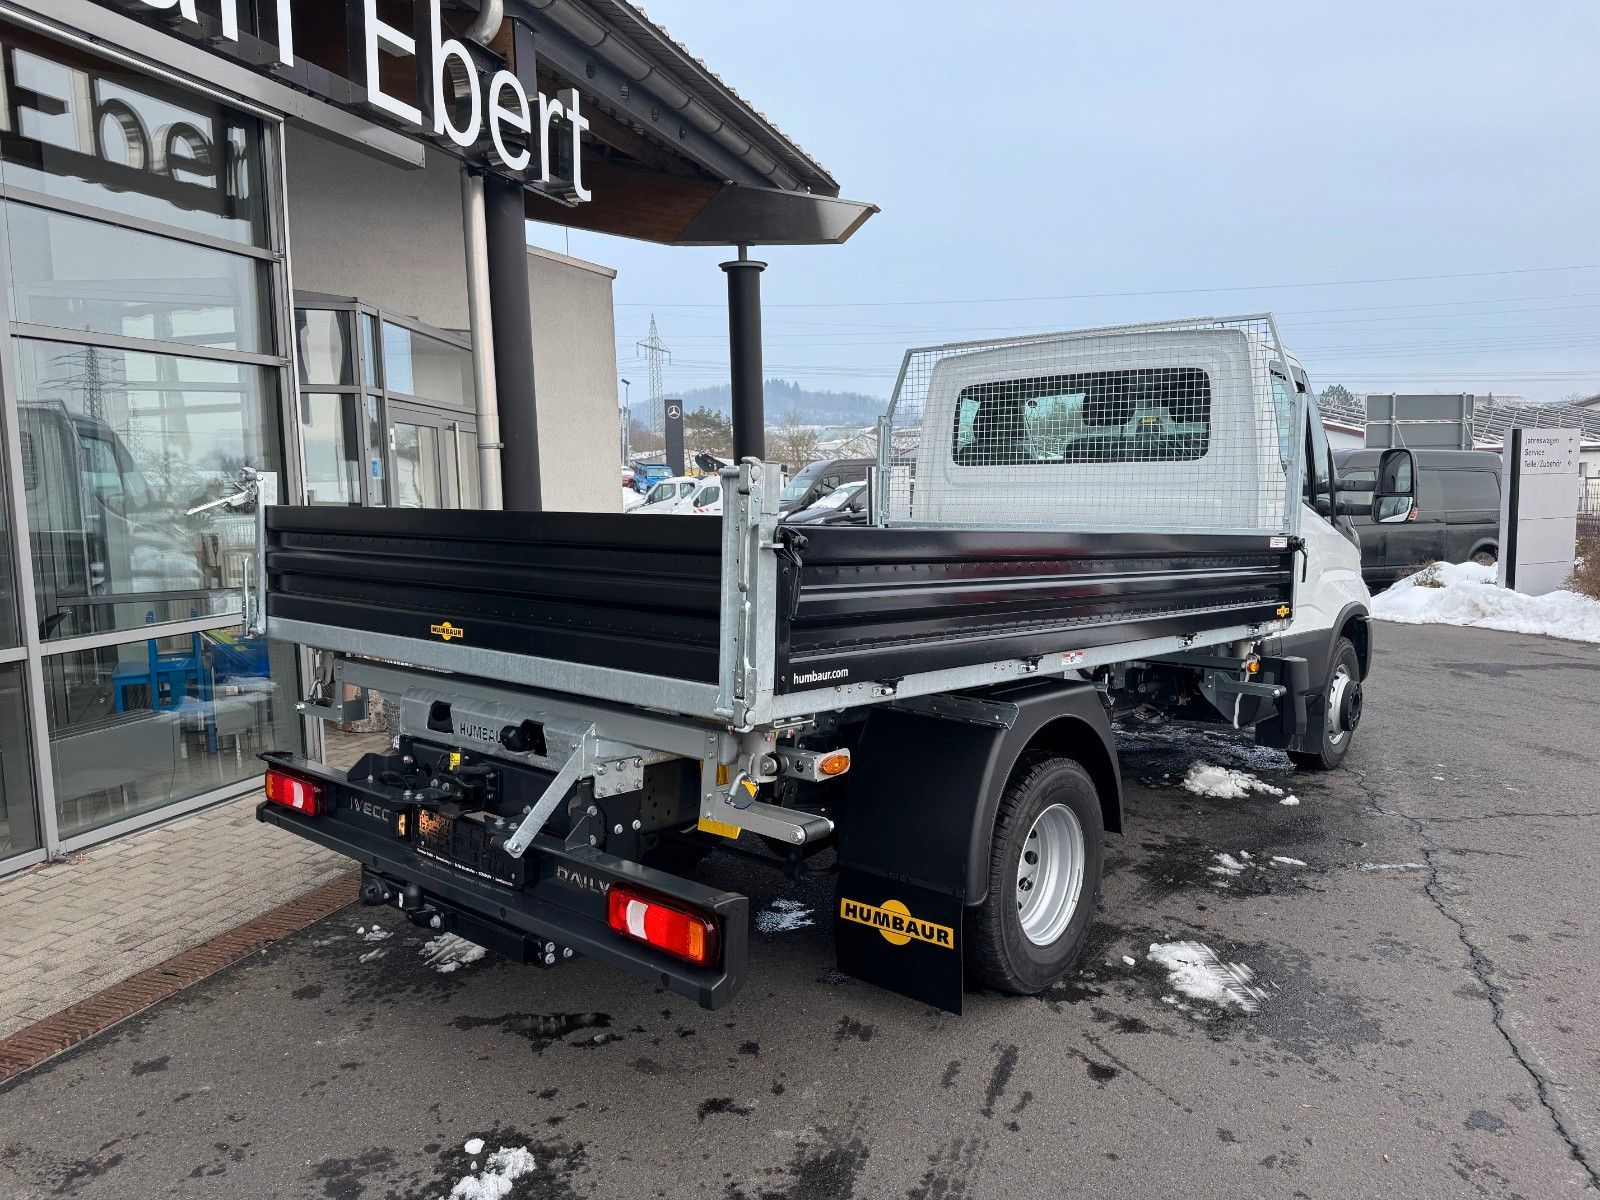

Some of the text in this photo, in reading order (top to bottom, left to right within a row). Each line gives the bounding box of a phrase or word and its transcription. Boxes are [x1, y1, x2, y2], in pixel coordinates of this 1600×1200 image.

[363, 0, 592, 202] Ebert
[1525, 437, 1560, 446] Jahreswagen
[1524, 459, 1562, 468] Teile/Zubehör
[432, 626, 462, 636] HUMBAUR
[793, 668, 849, 685] humbaur.com
[460, 722, 502, 744] HUMBAU
[556, 865, 611, 895] DAILY
[845, 901, 950, 946] HUMBAUR
